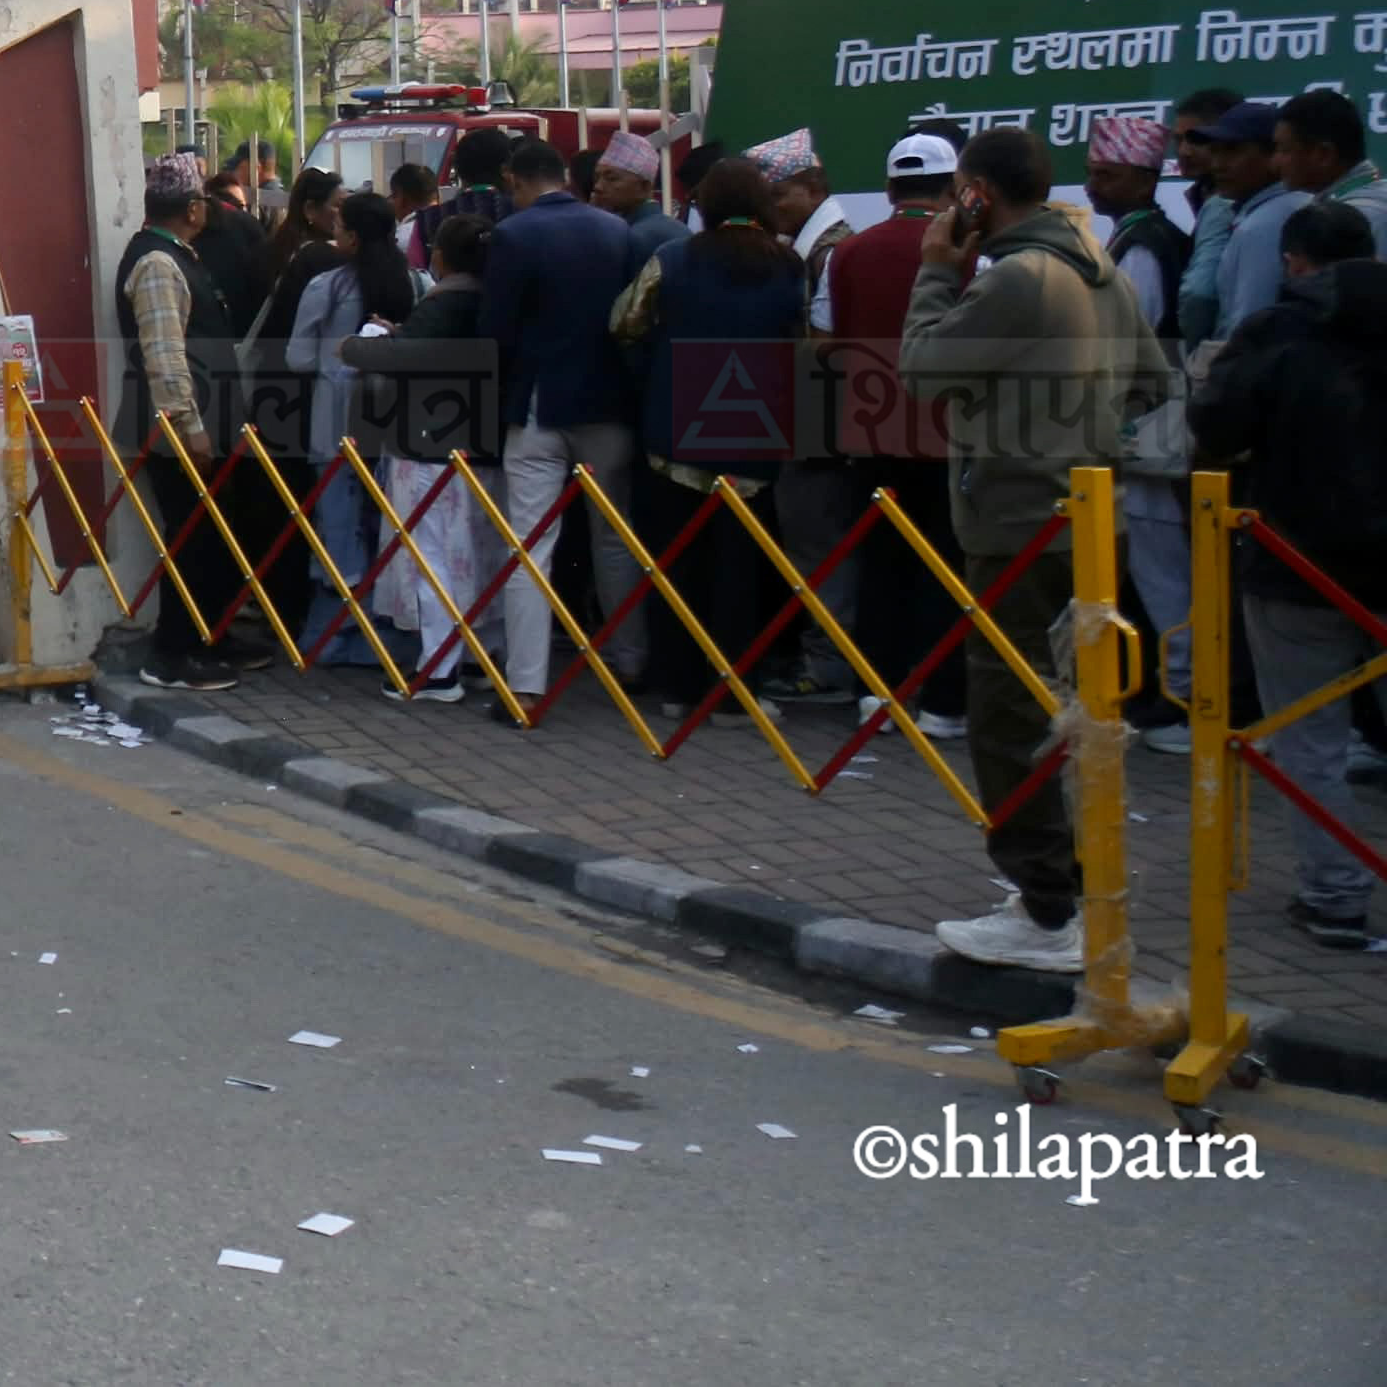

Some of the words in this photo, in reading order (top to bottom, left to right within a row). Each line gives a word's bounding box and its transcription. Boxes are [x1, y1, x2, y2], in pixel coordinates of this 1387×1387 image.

[835, 33, 1000, 87] निर्वाचन
[1012, 24, 1182, 76] स्थलमा
[1196, 10, 1338, 63] निम्न
